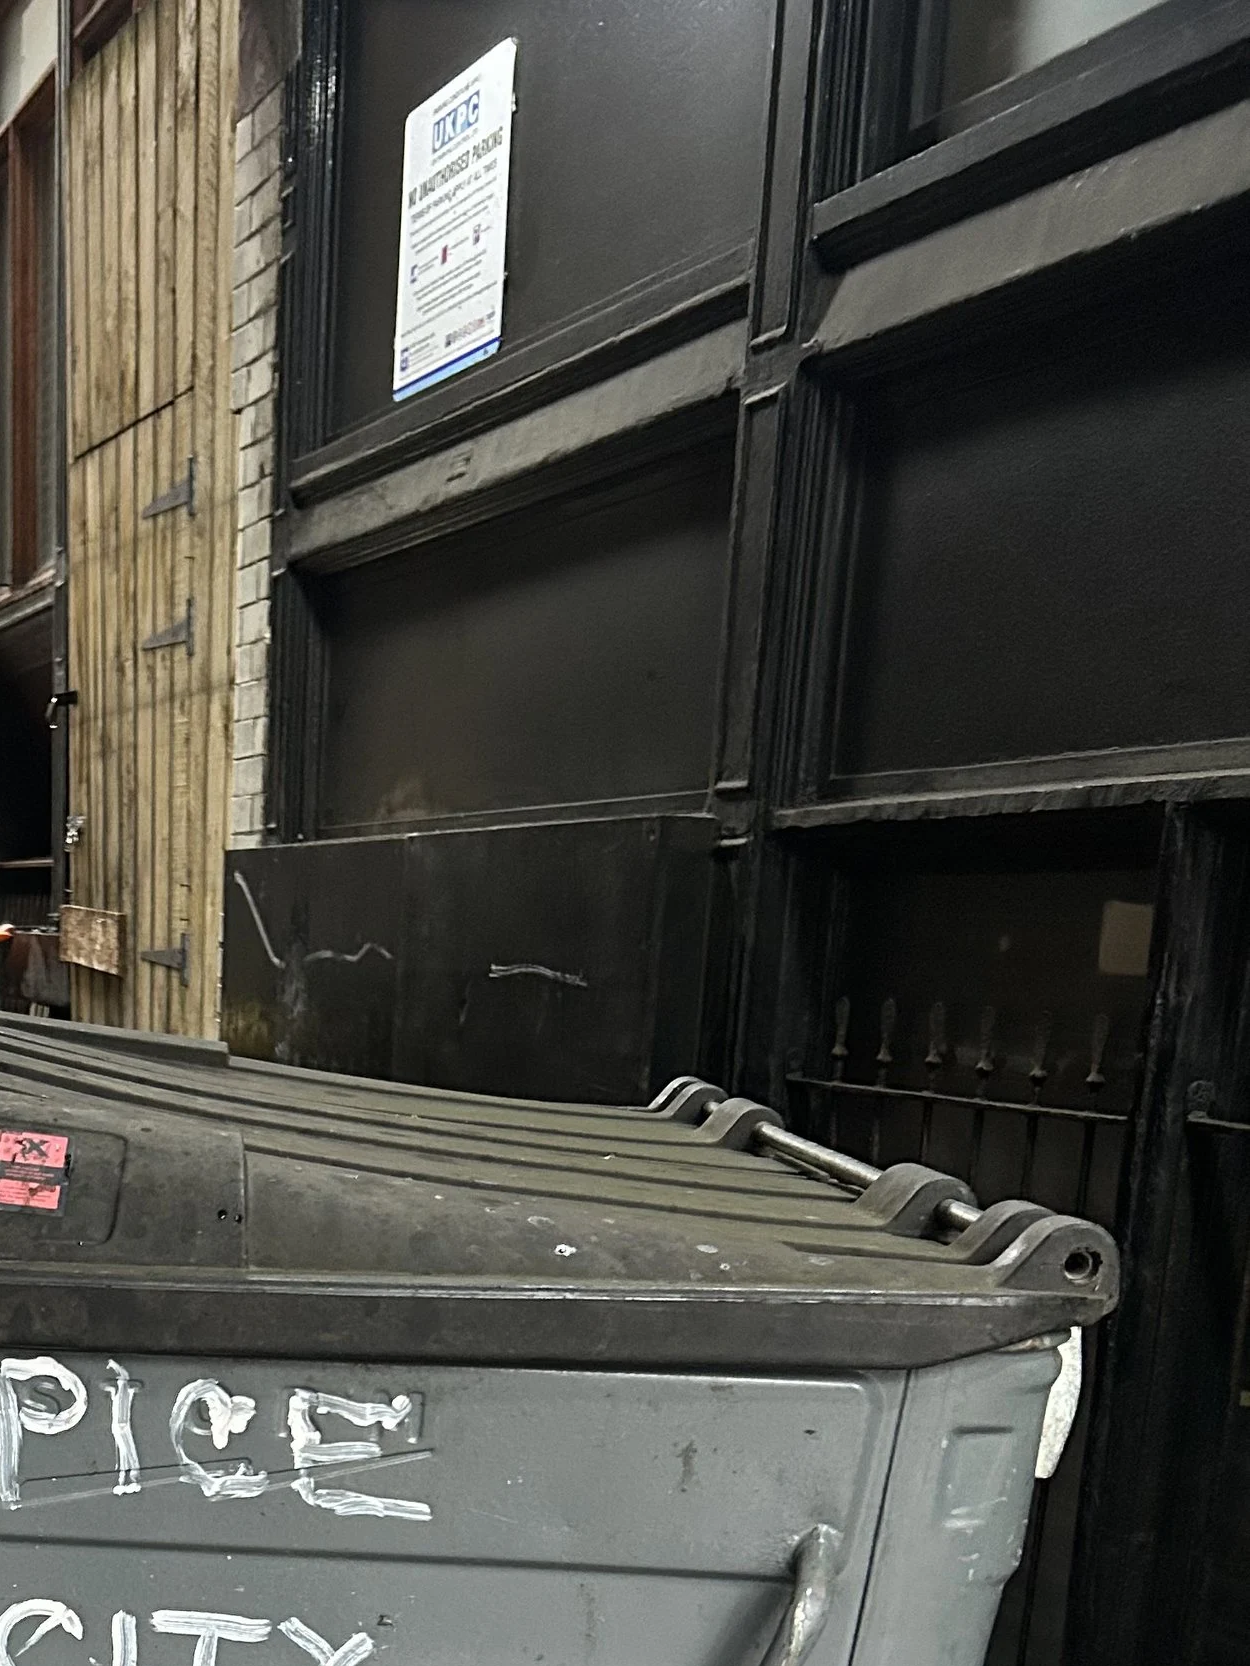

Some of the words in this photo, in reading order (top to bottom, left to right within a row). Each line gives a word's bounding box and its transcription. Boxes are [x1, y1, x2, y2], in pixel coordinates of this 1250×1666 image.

[434, 93, 479, 151] UKPC
[409, 187, 416, 207] NO
[418, 149, 469, 201] UNAUTHORISED
[472, 126, 503, 164] PARKING
